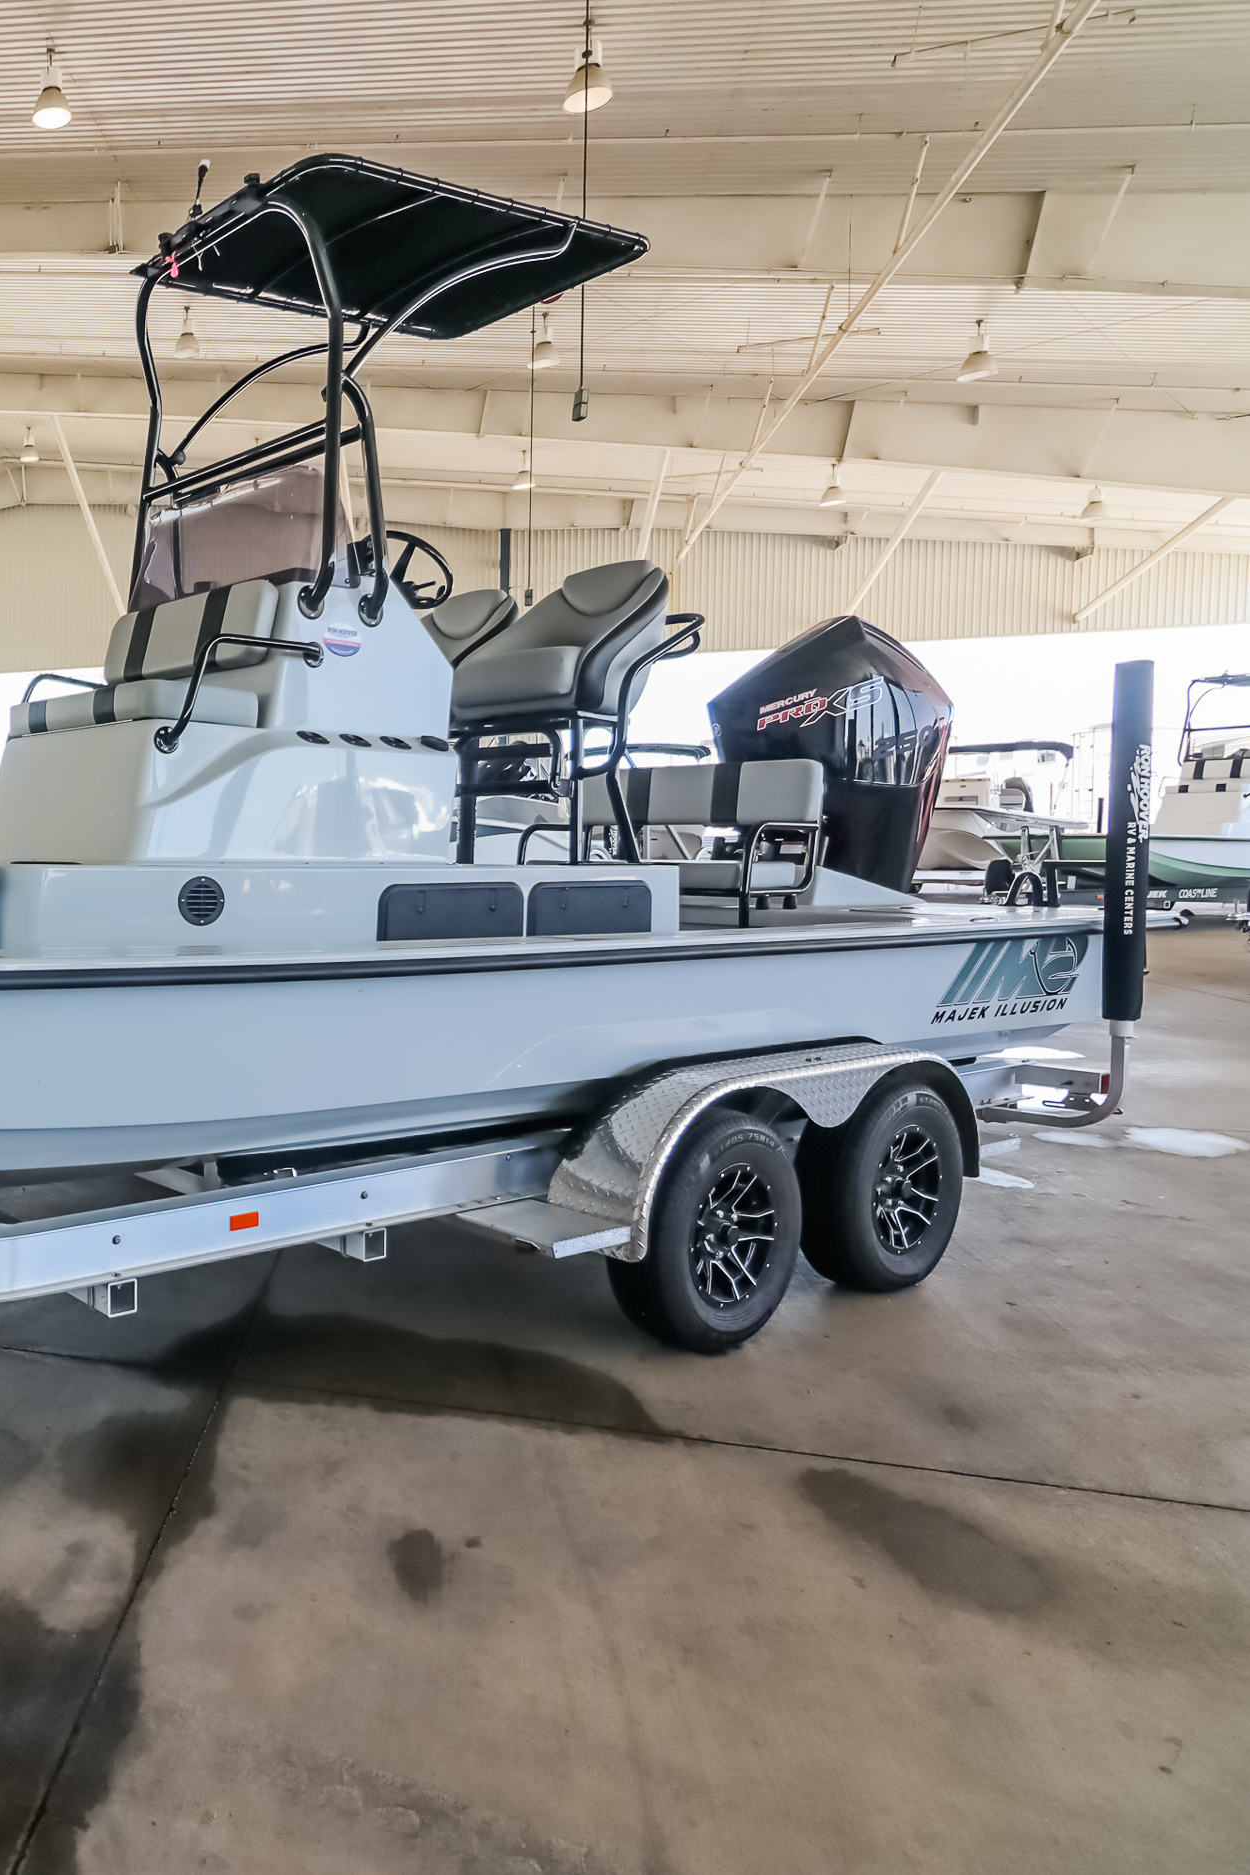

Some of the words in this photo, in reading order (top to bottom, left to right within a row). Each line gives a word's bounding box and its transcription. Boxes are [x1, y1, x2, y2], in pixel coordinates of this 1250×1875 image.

[760, 689, 817, 714] MERCURY
[872, 725, 935, 760] 250
[1139, 744, 1151, 777] RON
[1137, 777, 1150, 841] HOOVER
[1126, 837, 1137, 845] &
[1127, 822, 1137, 835] RV
[1124, 847, 1136, 887] MARINE
[1147, 890, 1168, 899] JEK
[1123, 889, 1135, 936] CENTERS
[930, 1005, 991, 1025] MAJEK
[994, 997, 1068, 1018] ILLUSION
